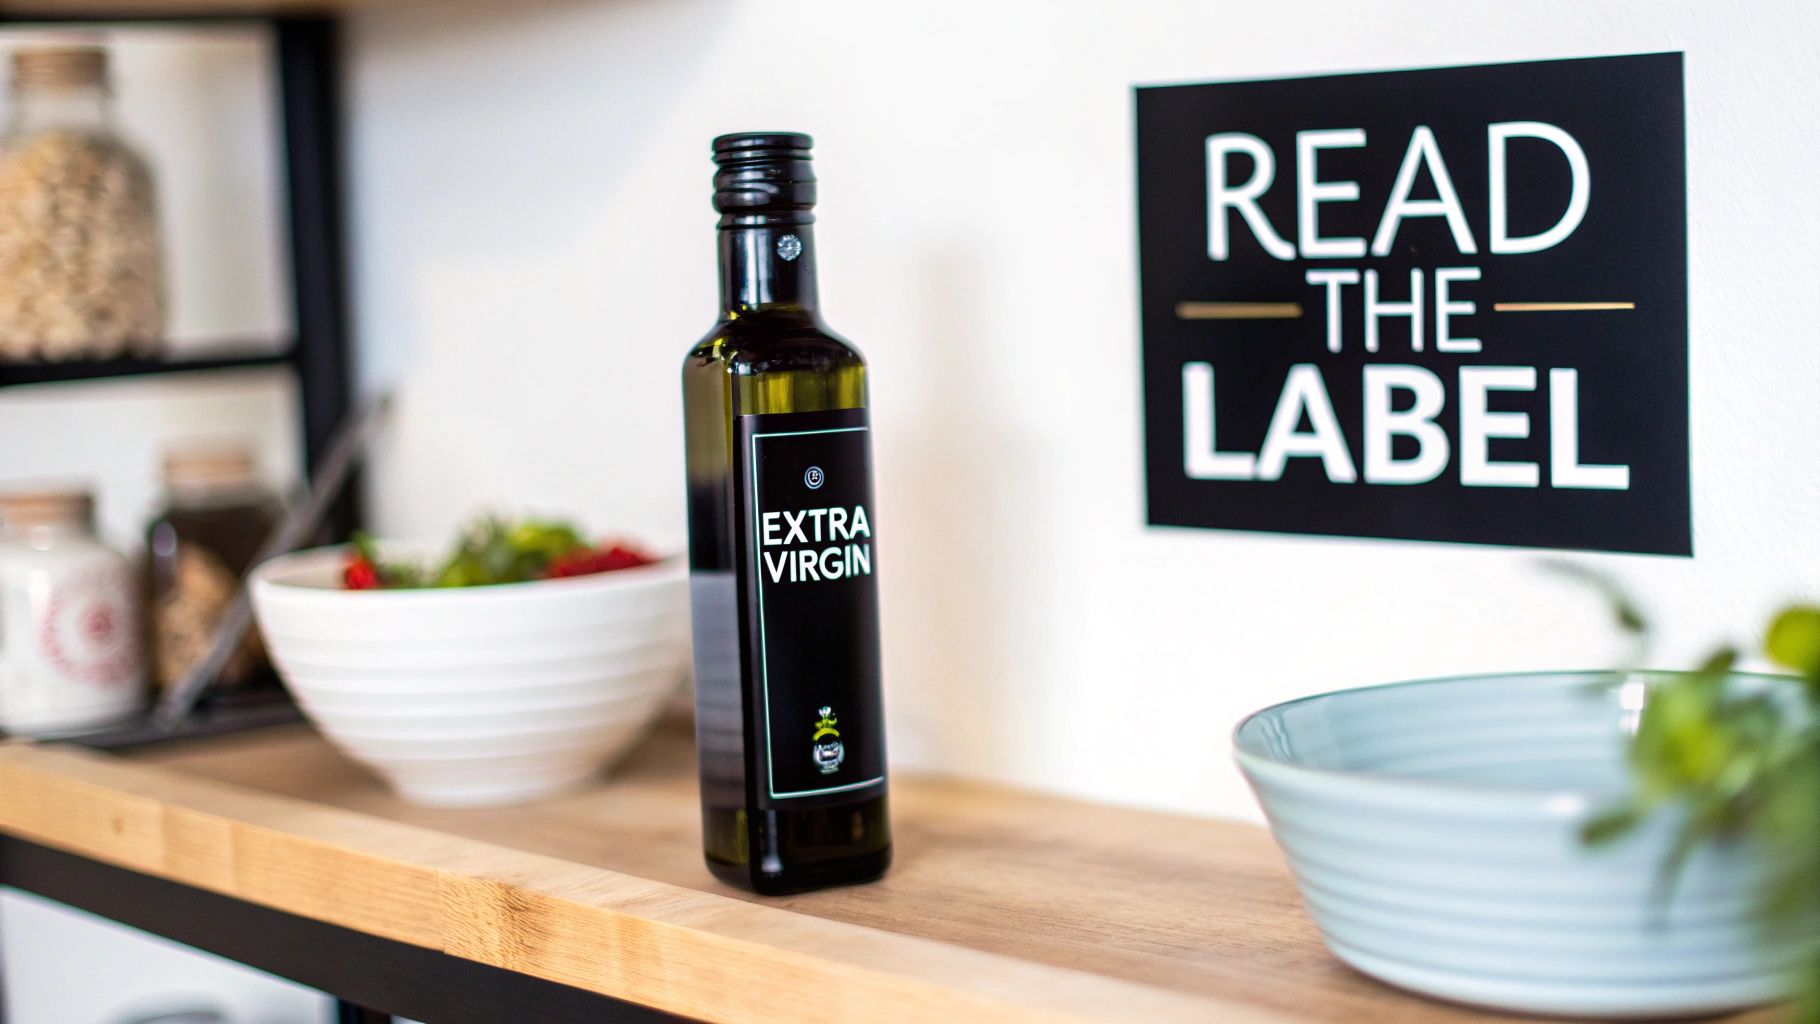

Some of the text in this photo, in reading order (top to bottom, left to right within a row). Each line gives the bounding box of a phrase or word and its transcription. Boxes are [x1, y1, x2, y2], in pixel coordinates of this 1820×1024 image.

[1205, 120, 1591, 261] READ
[1305, 267, 1482, 353] THE
[1182, 362, 1631, 490] LABEL
[762, 505, 871, 546] EXTRA
[763, 543, 871, 583] VIRGIN
